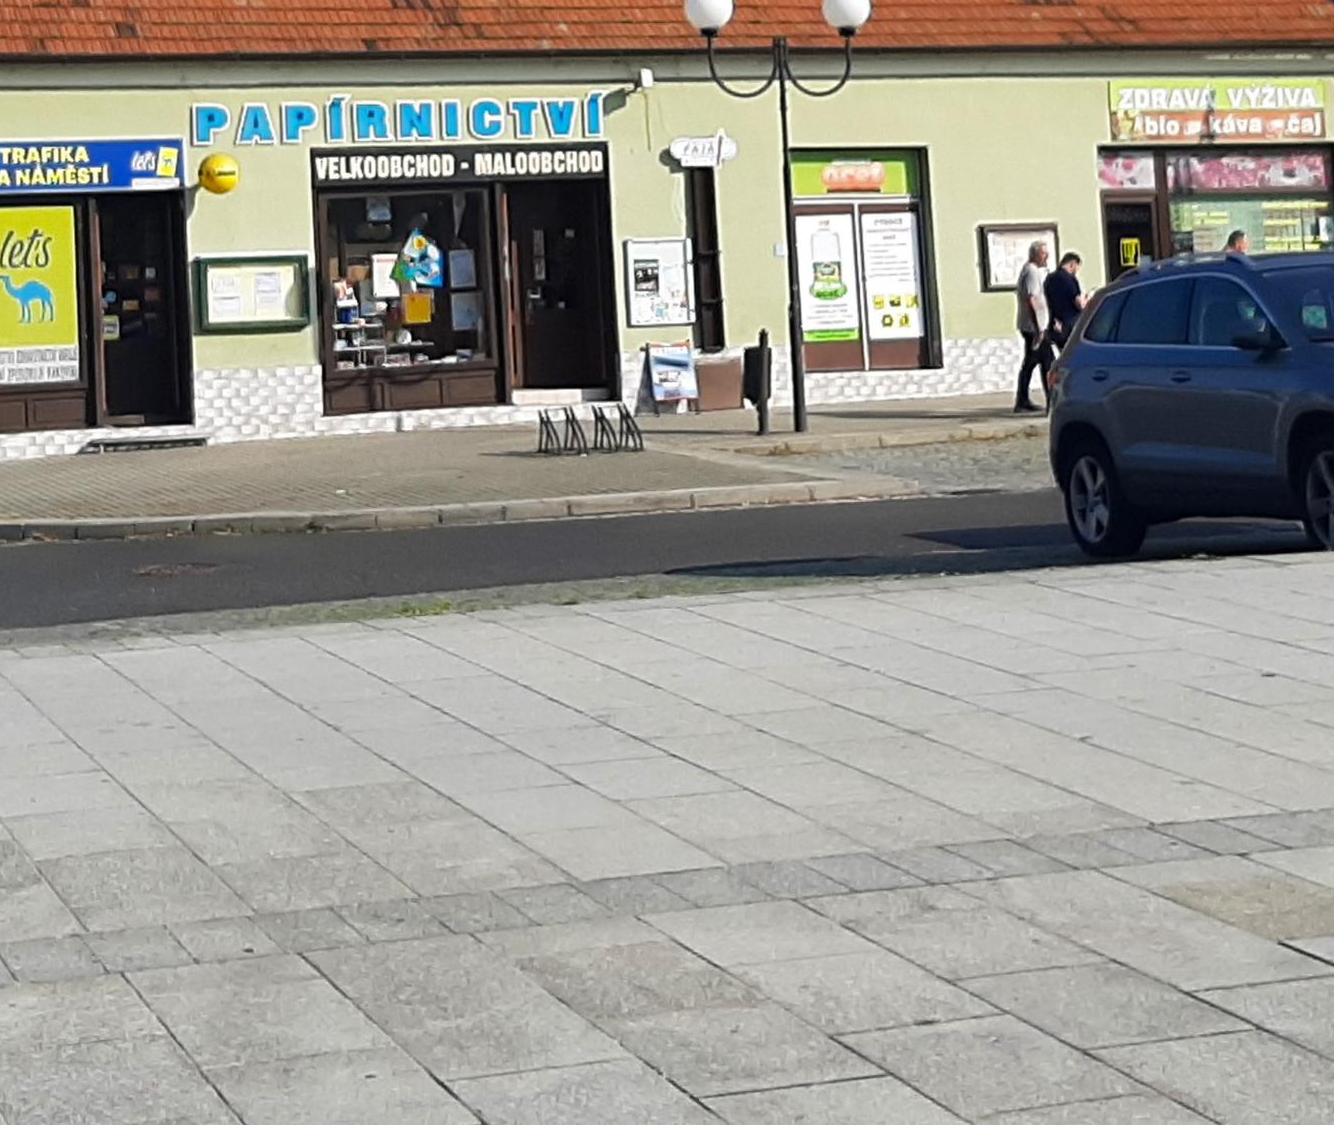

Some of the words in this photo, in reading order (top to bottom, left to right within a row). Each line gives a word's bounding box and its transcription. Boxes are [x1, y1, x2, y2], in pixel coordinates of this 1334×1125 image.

[1119, 83, 1216, 109] ZDRAVÁ
[1227, 83, 1316, 109] VÝŽIVA
[192, 93, 607, 146] PAPÍRNICTVÍ
[1145, 117, 1180, 136] bio
[1210, 114, 1263, 135] káva
[1288, 113, 1322, 137] čaj
[15, 163, 110, 186] NÁMĚSTÍ
[315, 154, 456, 181] VELKOOBCHOD
[474, 150, 604, 176] MALOOBCHOD
